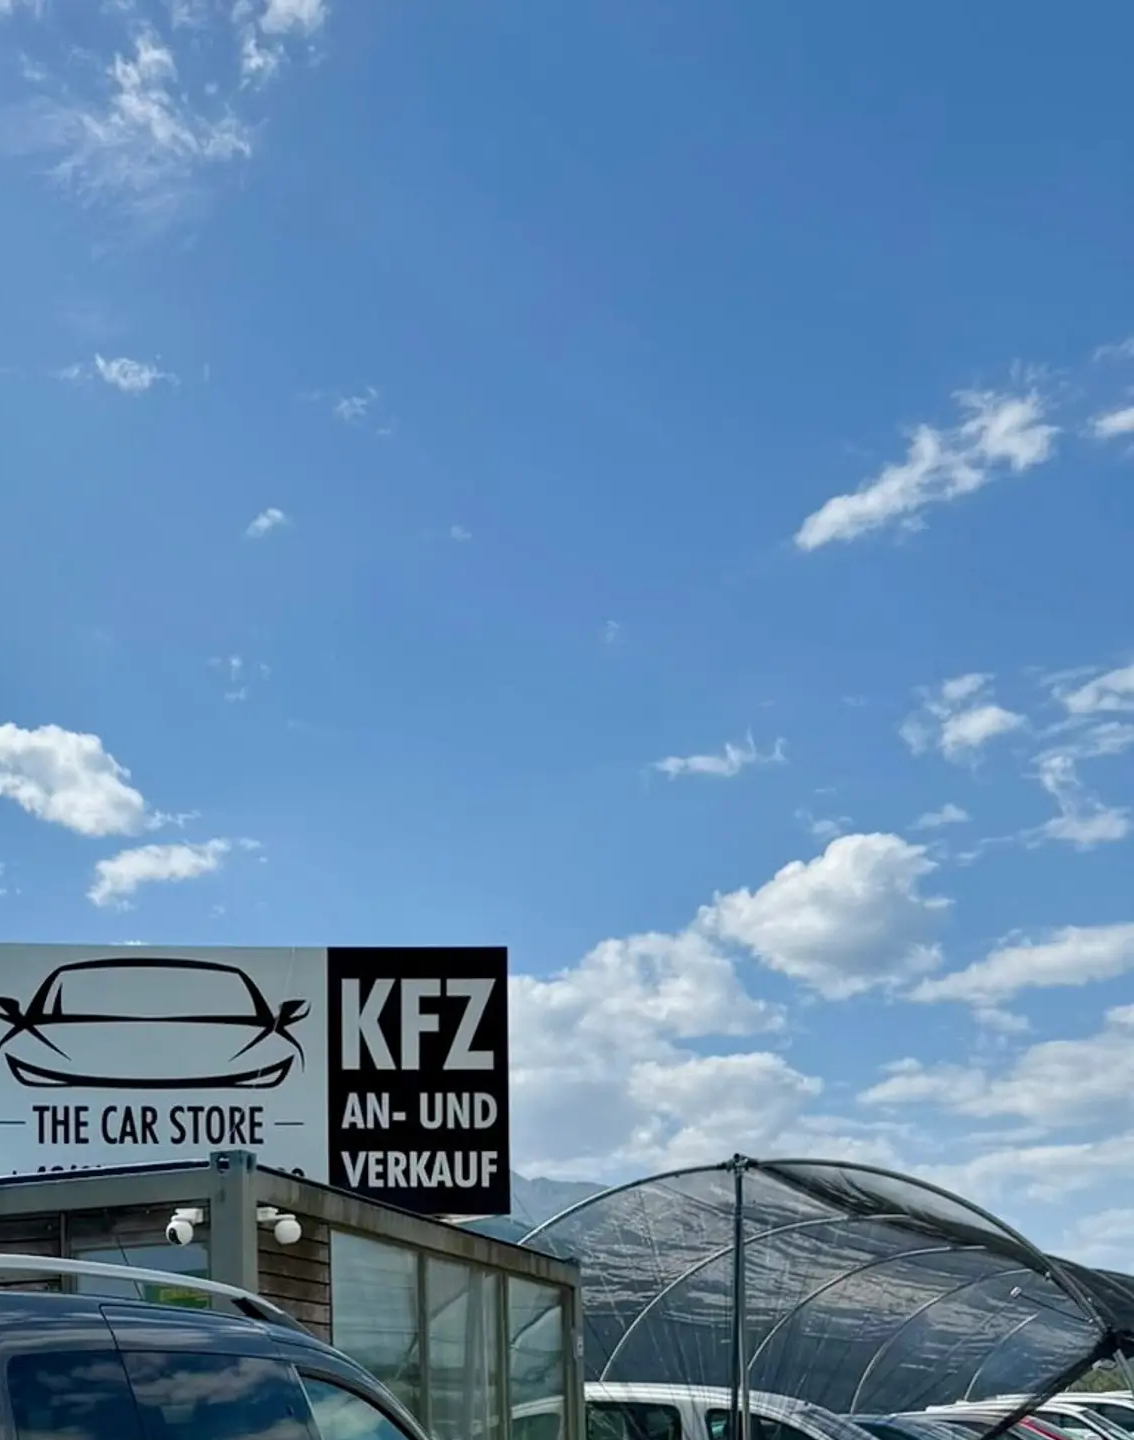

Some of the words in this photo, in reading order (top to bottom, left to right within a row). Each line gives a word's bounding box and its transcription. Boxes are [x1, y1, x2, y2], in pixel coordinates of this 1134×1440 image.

[341, 978, 496, 1071] KFZ
[33, 1105, 89, 1144] THE
[101, 1105, 159, 1145] CAR
[170, 1105, 264, 1145] STORE
[341, 1092, 406, 1130] AN-
[420, 1092, 498, 1130] UND
[341, 1150, 498, 1189] VERKAUF
